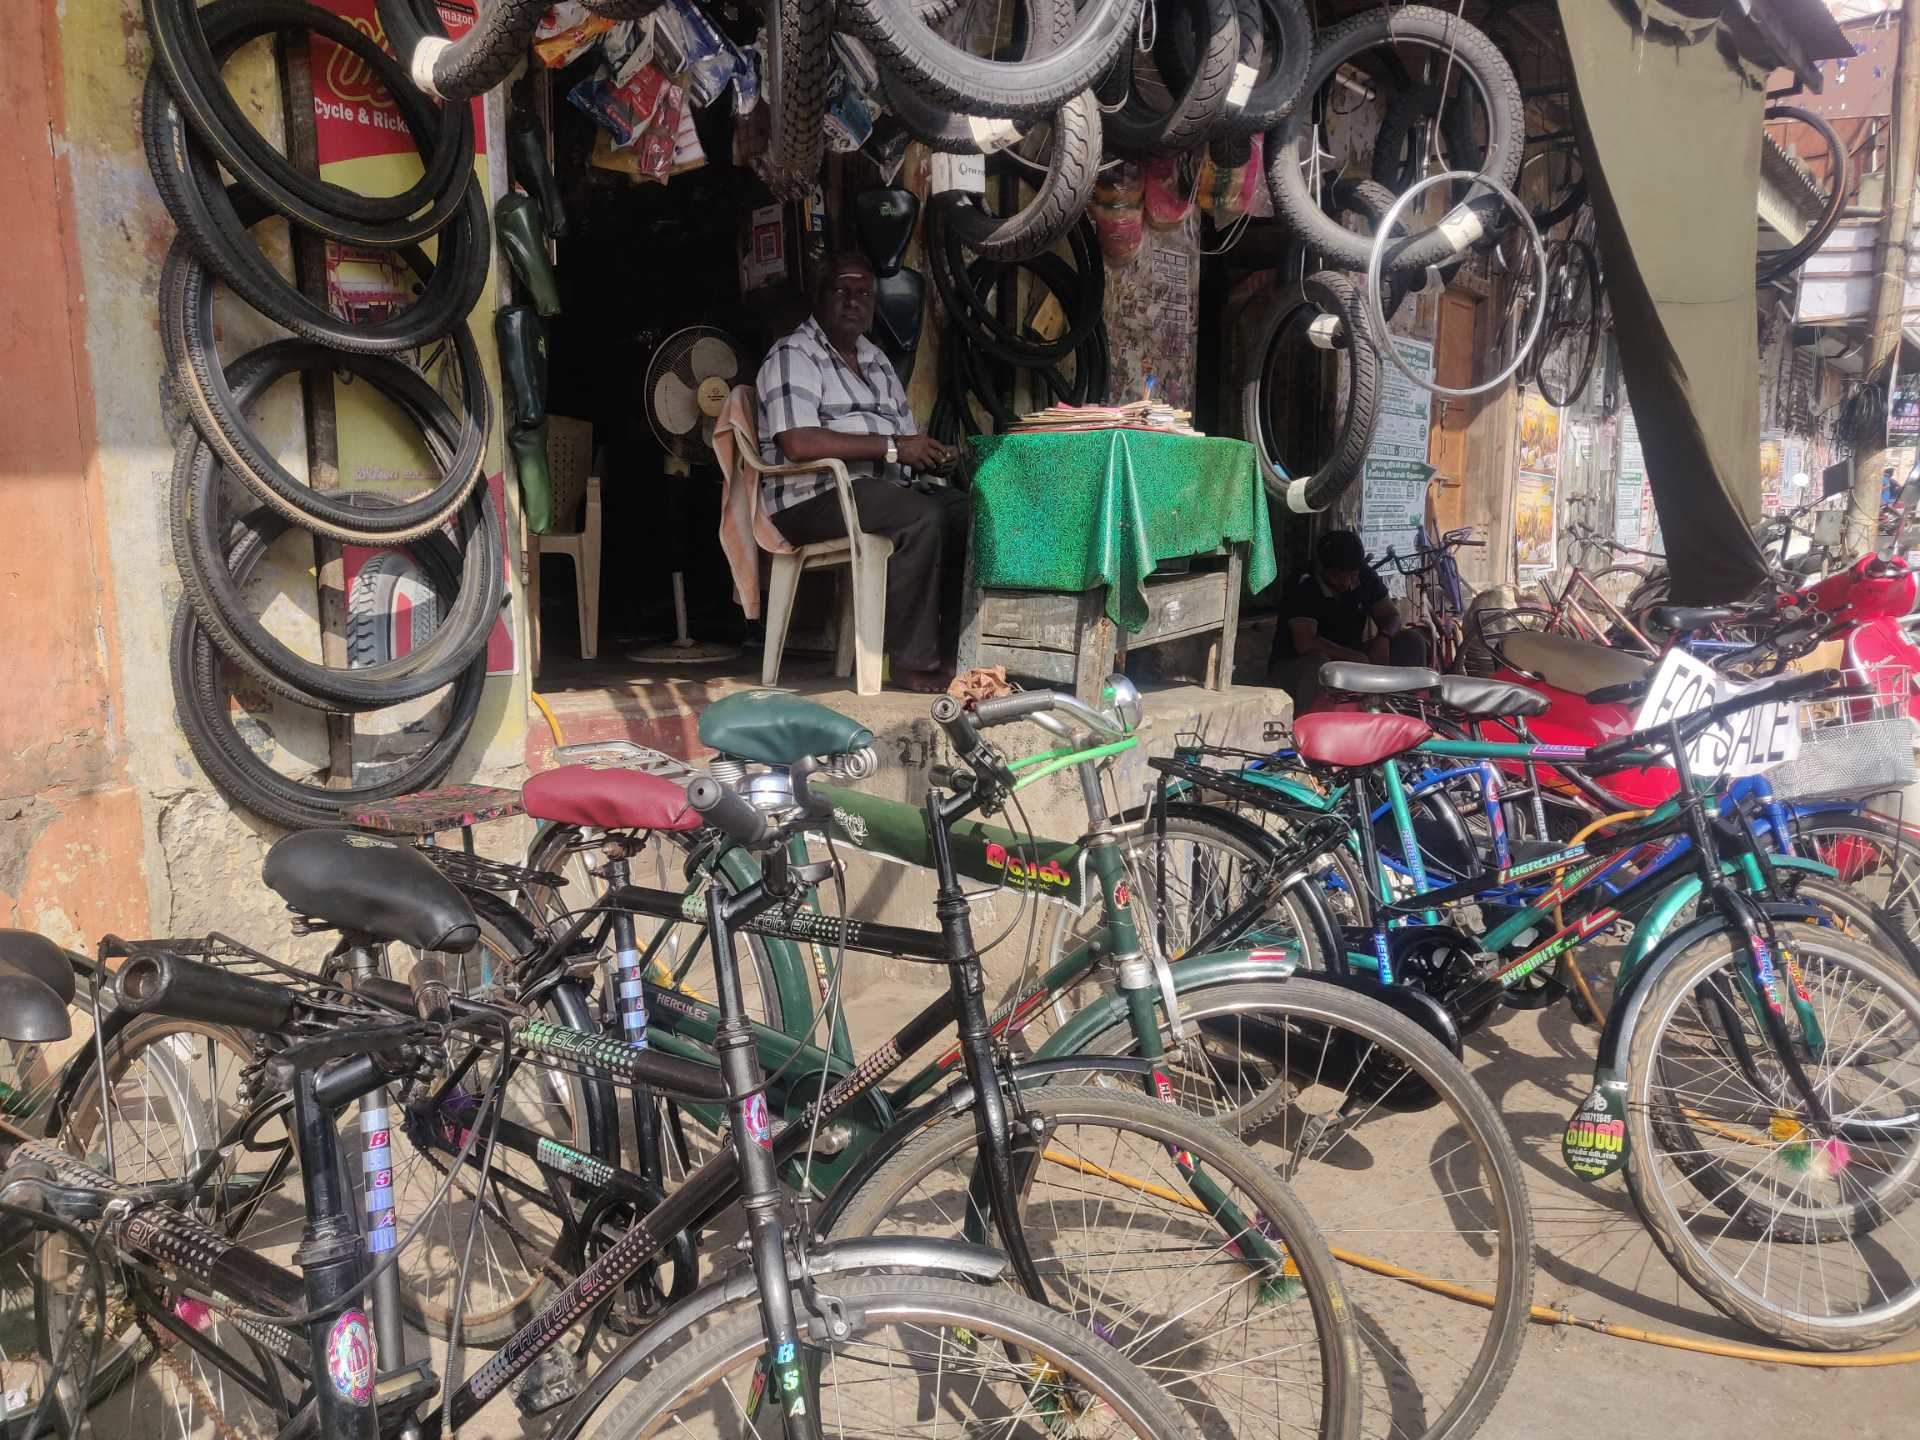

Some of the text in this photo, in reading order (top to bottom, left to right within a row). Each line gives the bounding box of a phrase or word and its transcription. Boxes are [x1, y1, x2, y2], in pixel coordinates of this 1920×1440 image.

[313, 96, 354, 122] Cycle
[358, 107, 370, 126] &
[1508, 845, 1586, 878] HERCULES
[656, 992, 709, 1021] HERCULES
[549, 1029, 598, 1056] SLR
